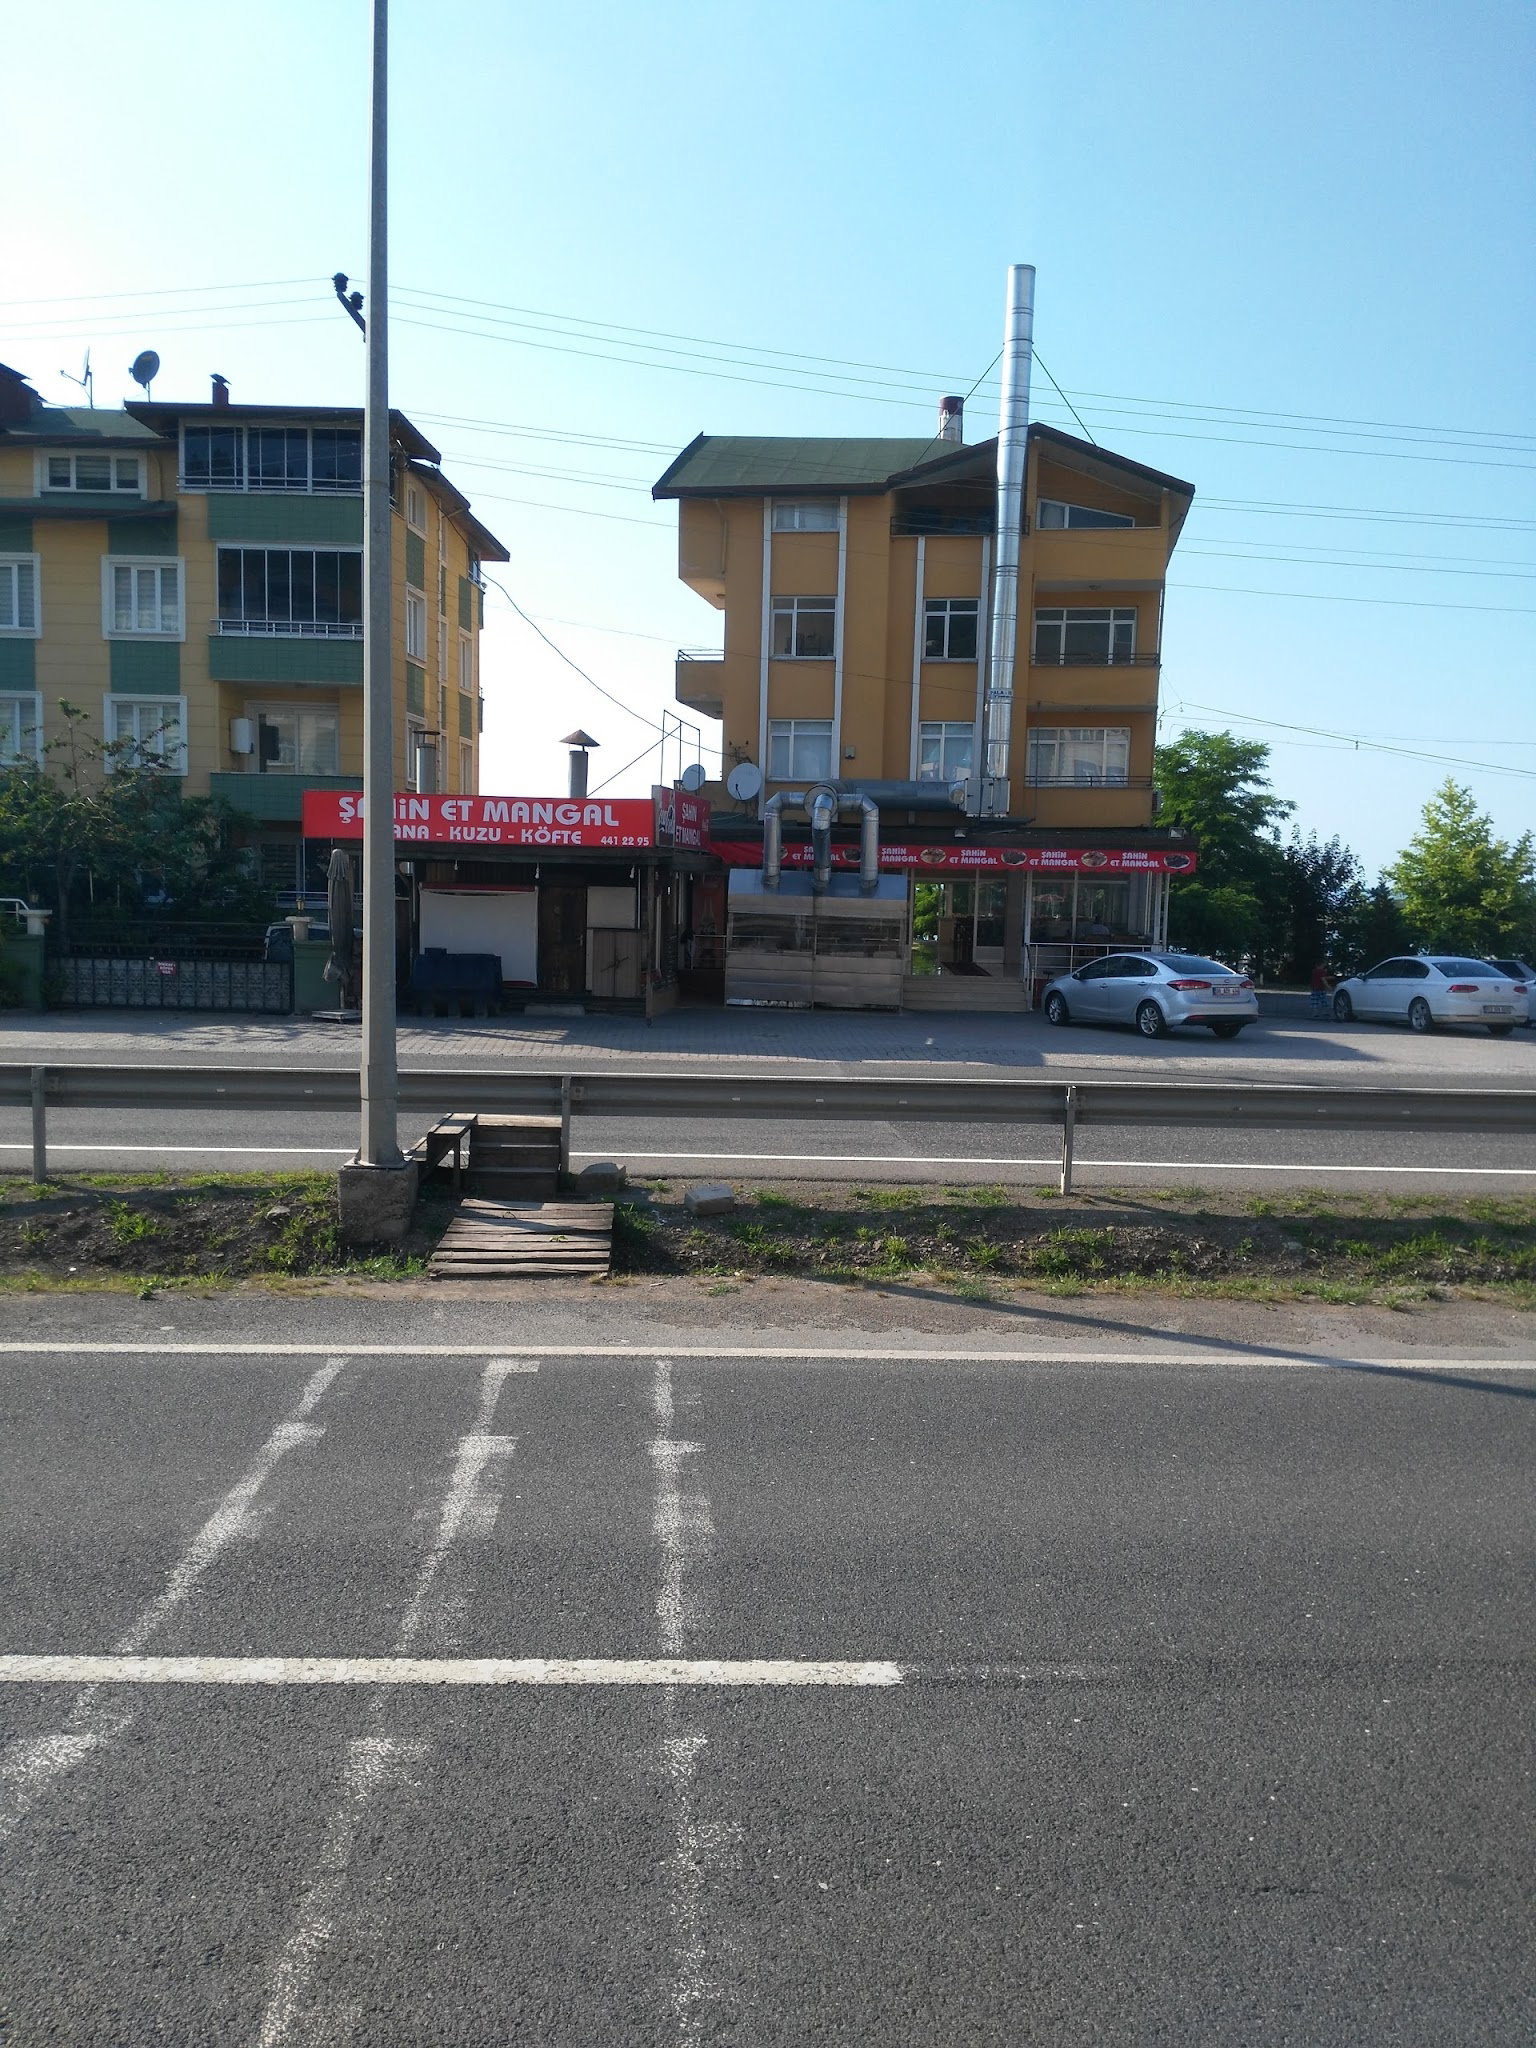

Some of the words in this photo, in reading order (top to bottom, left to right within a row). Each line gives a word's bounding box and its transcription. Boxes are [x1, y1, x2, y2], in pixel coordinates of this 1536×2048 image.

[338, 797, 429, 823] ŞİN
[441, 800, 473, 821] ET
[483, 801, 619, 827] MANGAL
[393, 824, 429, 840] ANA
[450, 826, 501, 842] KUZU
[521, 826, 582, 845] KÖFTE
[600, 836, 618, 845] 441
[622, 836, 634, 846] 22
[638, 837, 649, 847] 95
[960, 857, 998, 865] MANGAL
[1122, 860, 1160, 868] MANGAL
